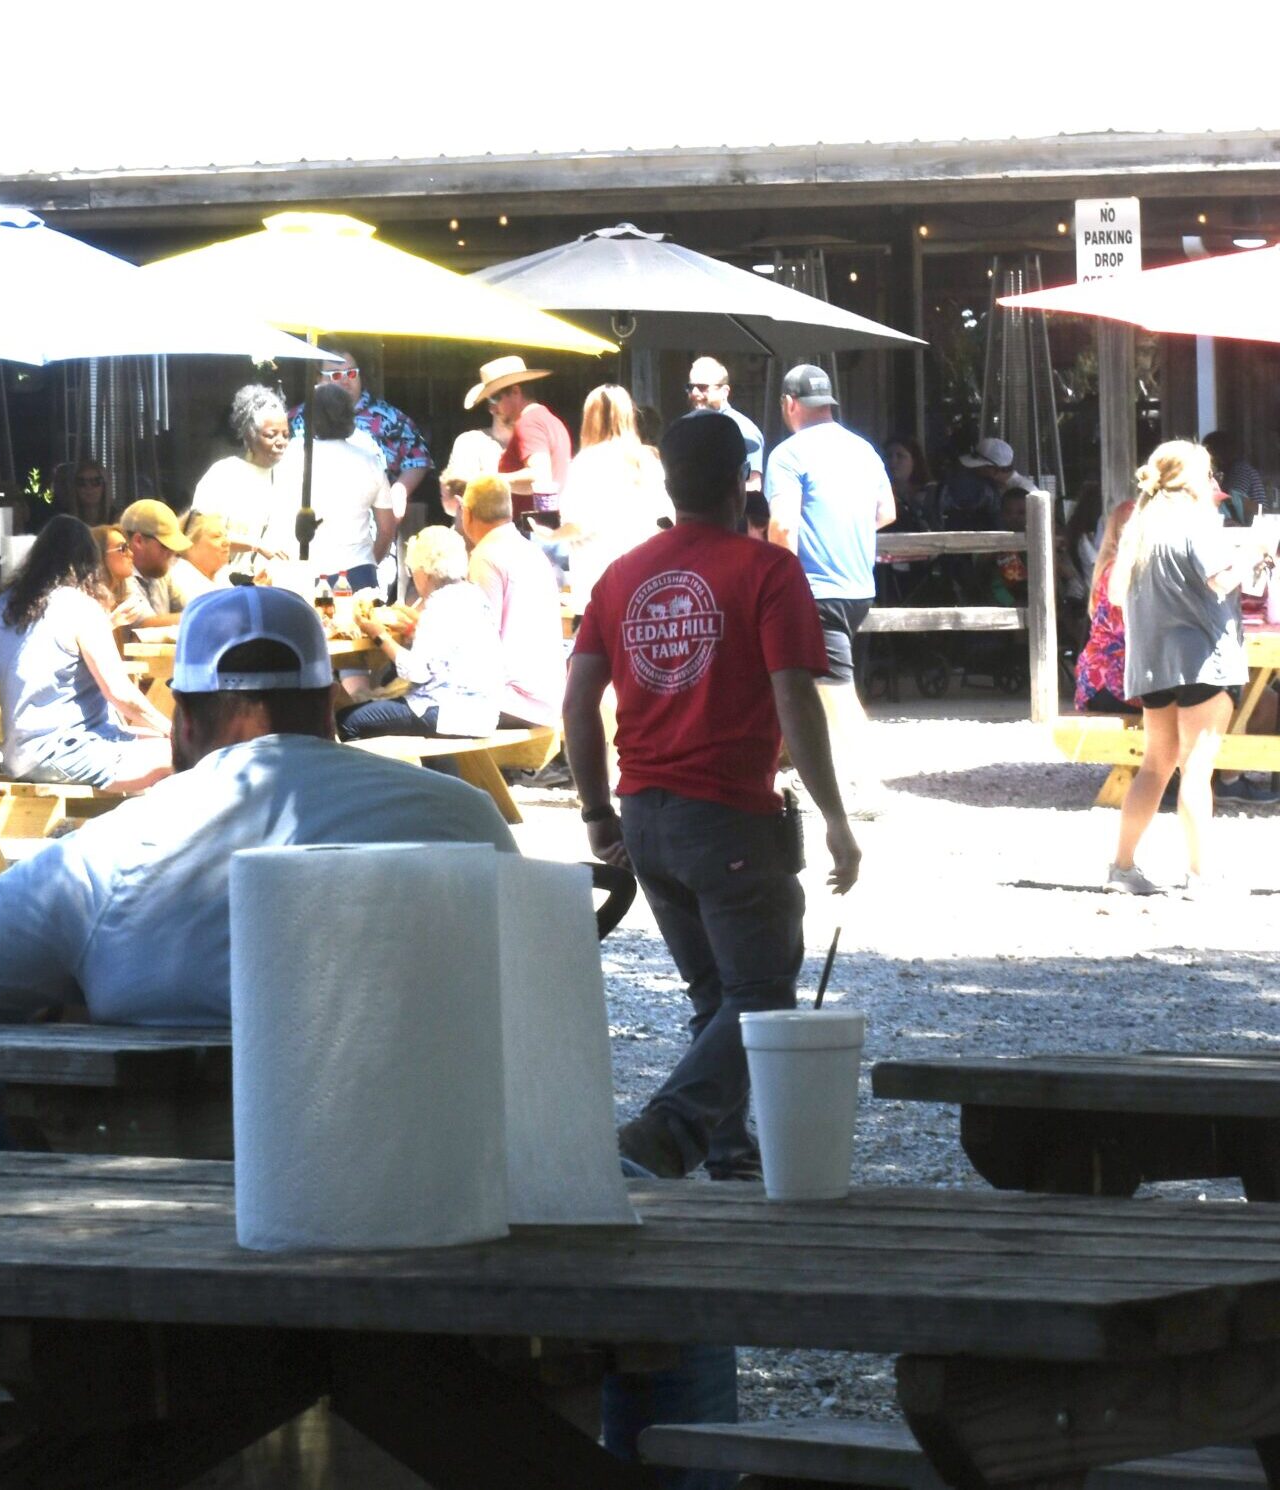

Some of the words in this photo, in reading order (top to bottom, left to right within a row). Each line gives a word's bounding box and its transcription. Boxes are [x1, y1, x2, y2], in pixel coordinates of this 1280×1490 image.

[1100, 207, 1116, 223] NO
[1084, 229, 1133, 246] PARKING
[1094, 252, 1124, 268] DROP
[626, 621, 678, 644] CEDAR
[682, 617, 718, 638] HILL
[651, 639, 690, 661] FARM
